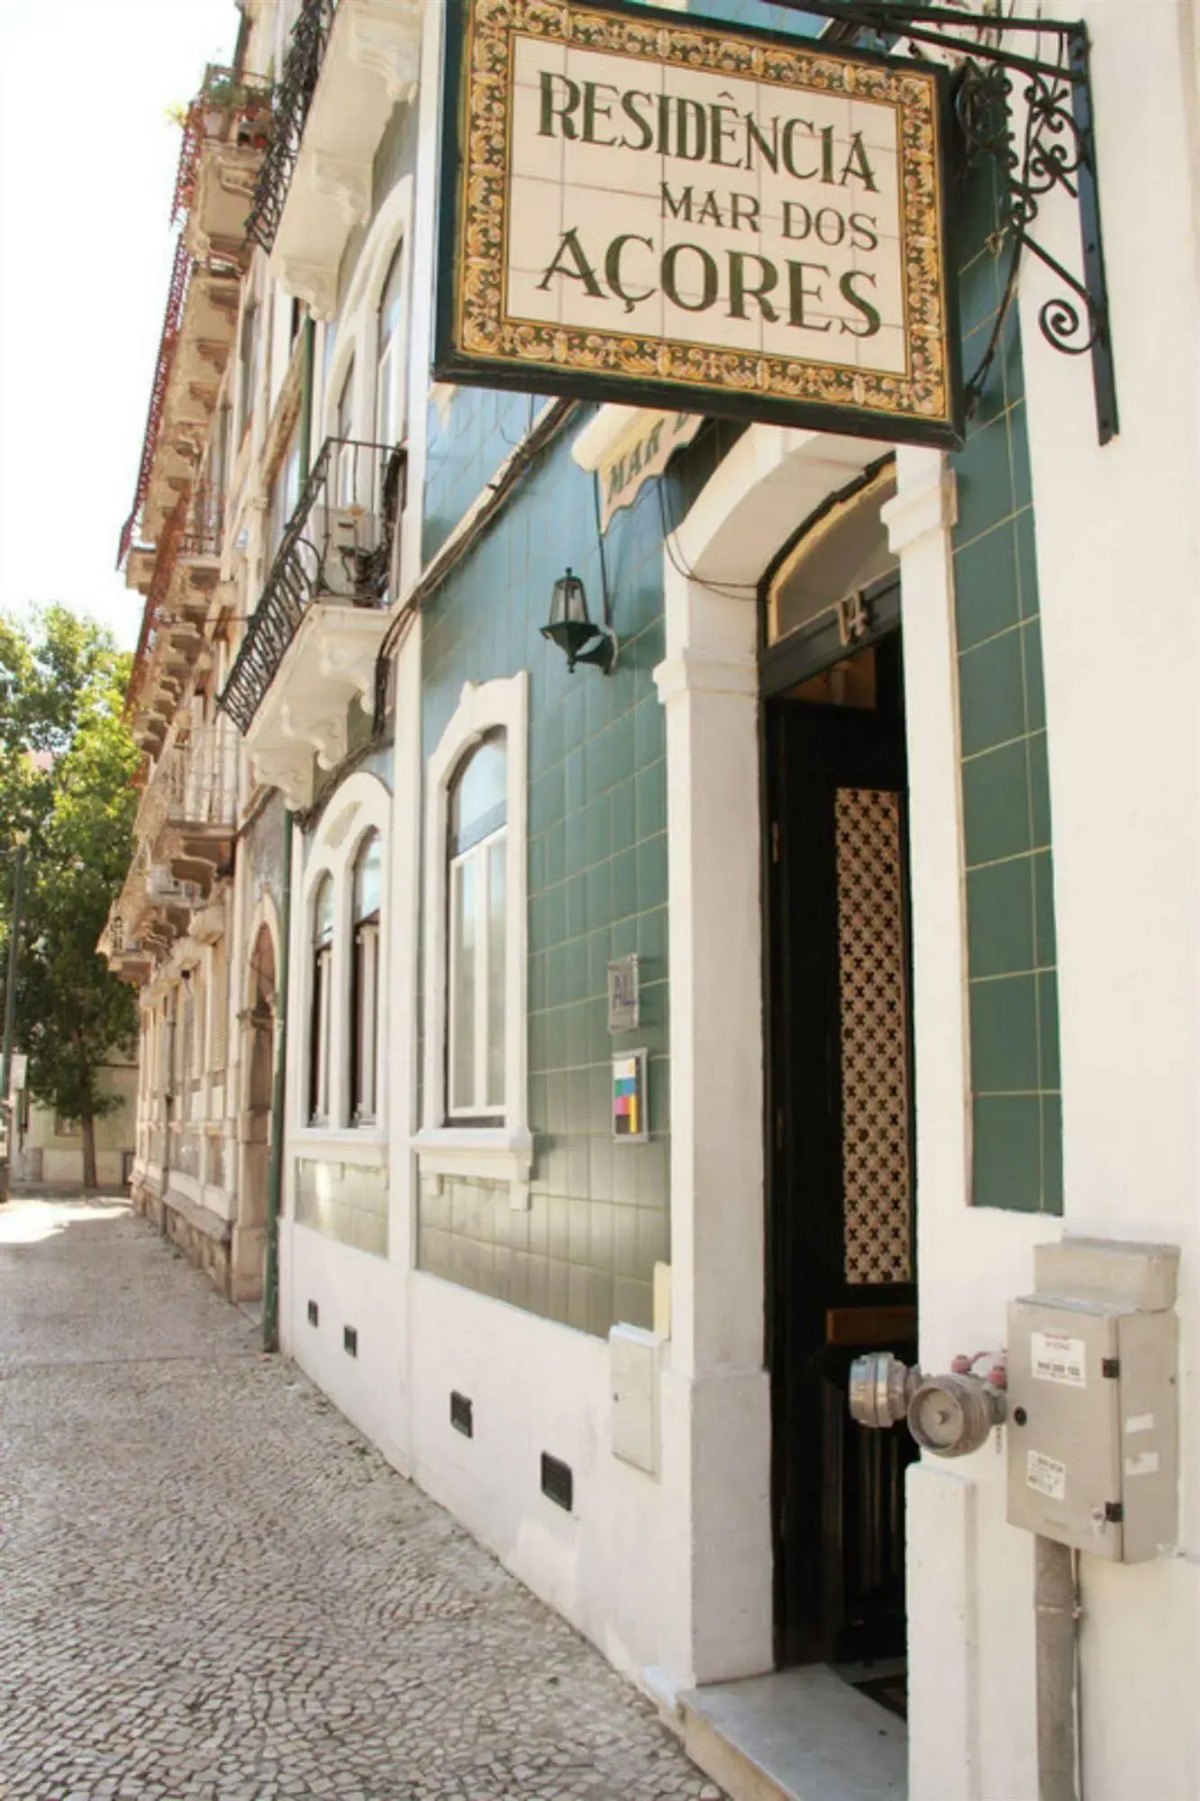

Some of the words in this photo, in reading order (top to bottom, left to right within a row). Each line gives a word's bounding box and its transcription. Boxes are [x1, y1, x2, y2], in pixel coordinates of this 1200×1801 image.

[538, 70, 881, 194] RESIDÊNCIA
[660, 181, 760, 233] MAR
[782, 200, 878, 251] DOS
[536, 226, 882, 339] AÇORES
